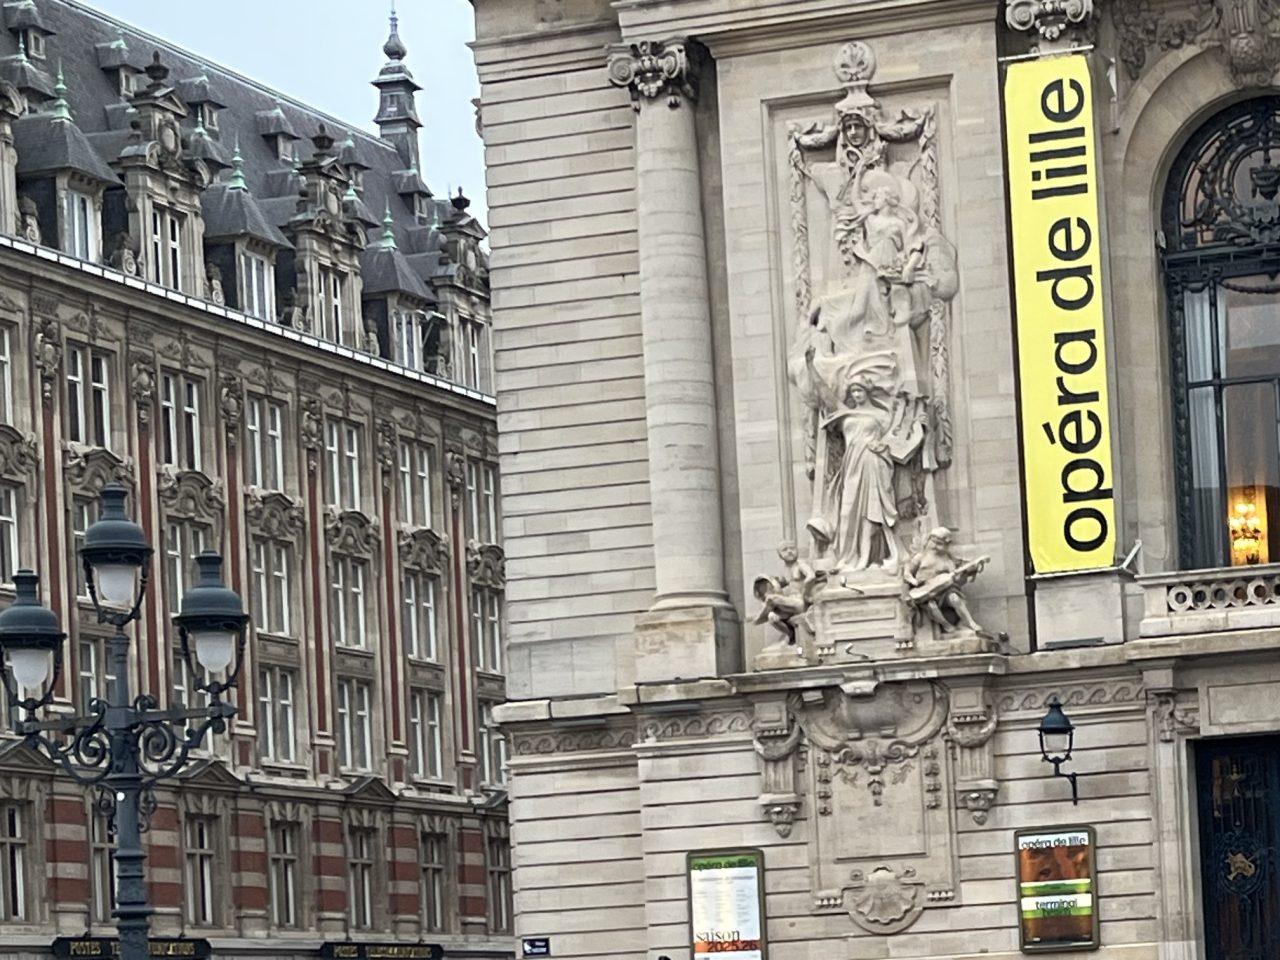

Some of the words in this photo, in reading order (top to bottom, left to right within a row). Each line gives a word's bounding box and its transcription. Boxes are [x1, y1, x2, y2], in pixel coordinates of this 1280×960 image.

[1028, 77, 1089, 201] lille
[1036, 216, 1096, 311] de
[1043, 328, 1114, 552] opéra
[695, 928, 741, 943] saison
